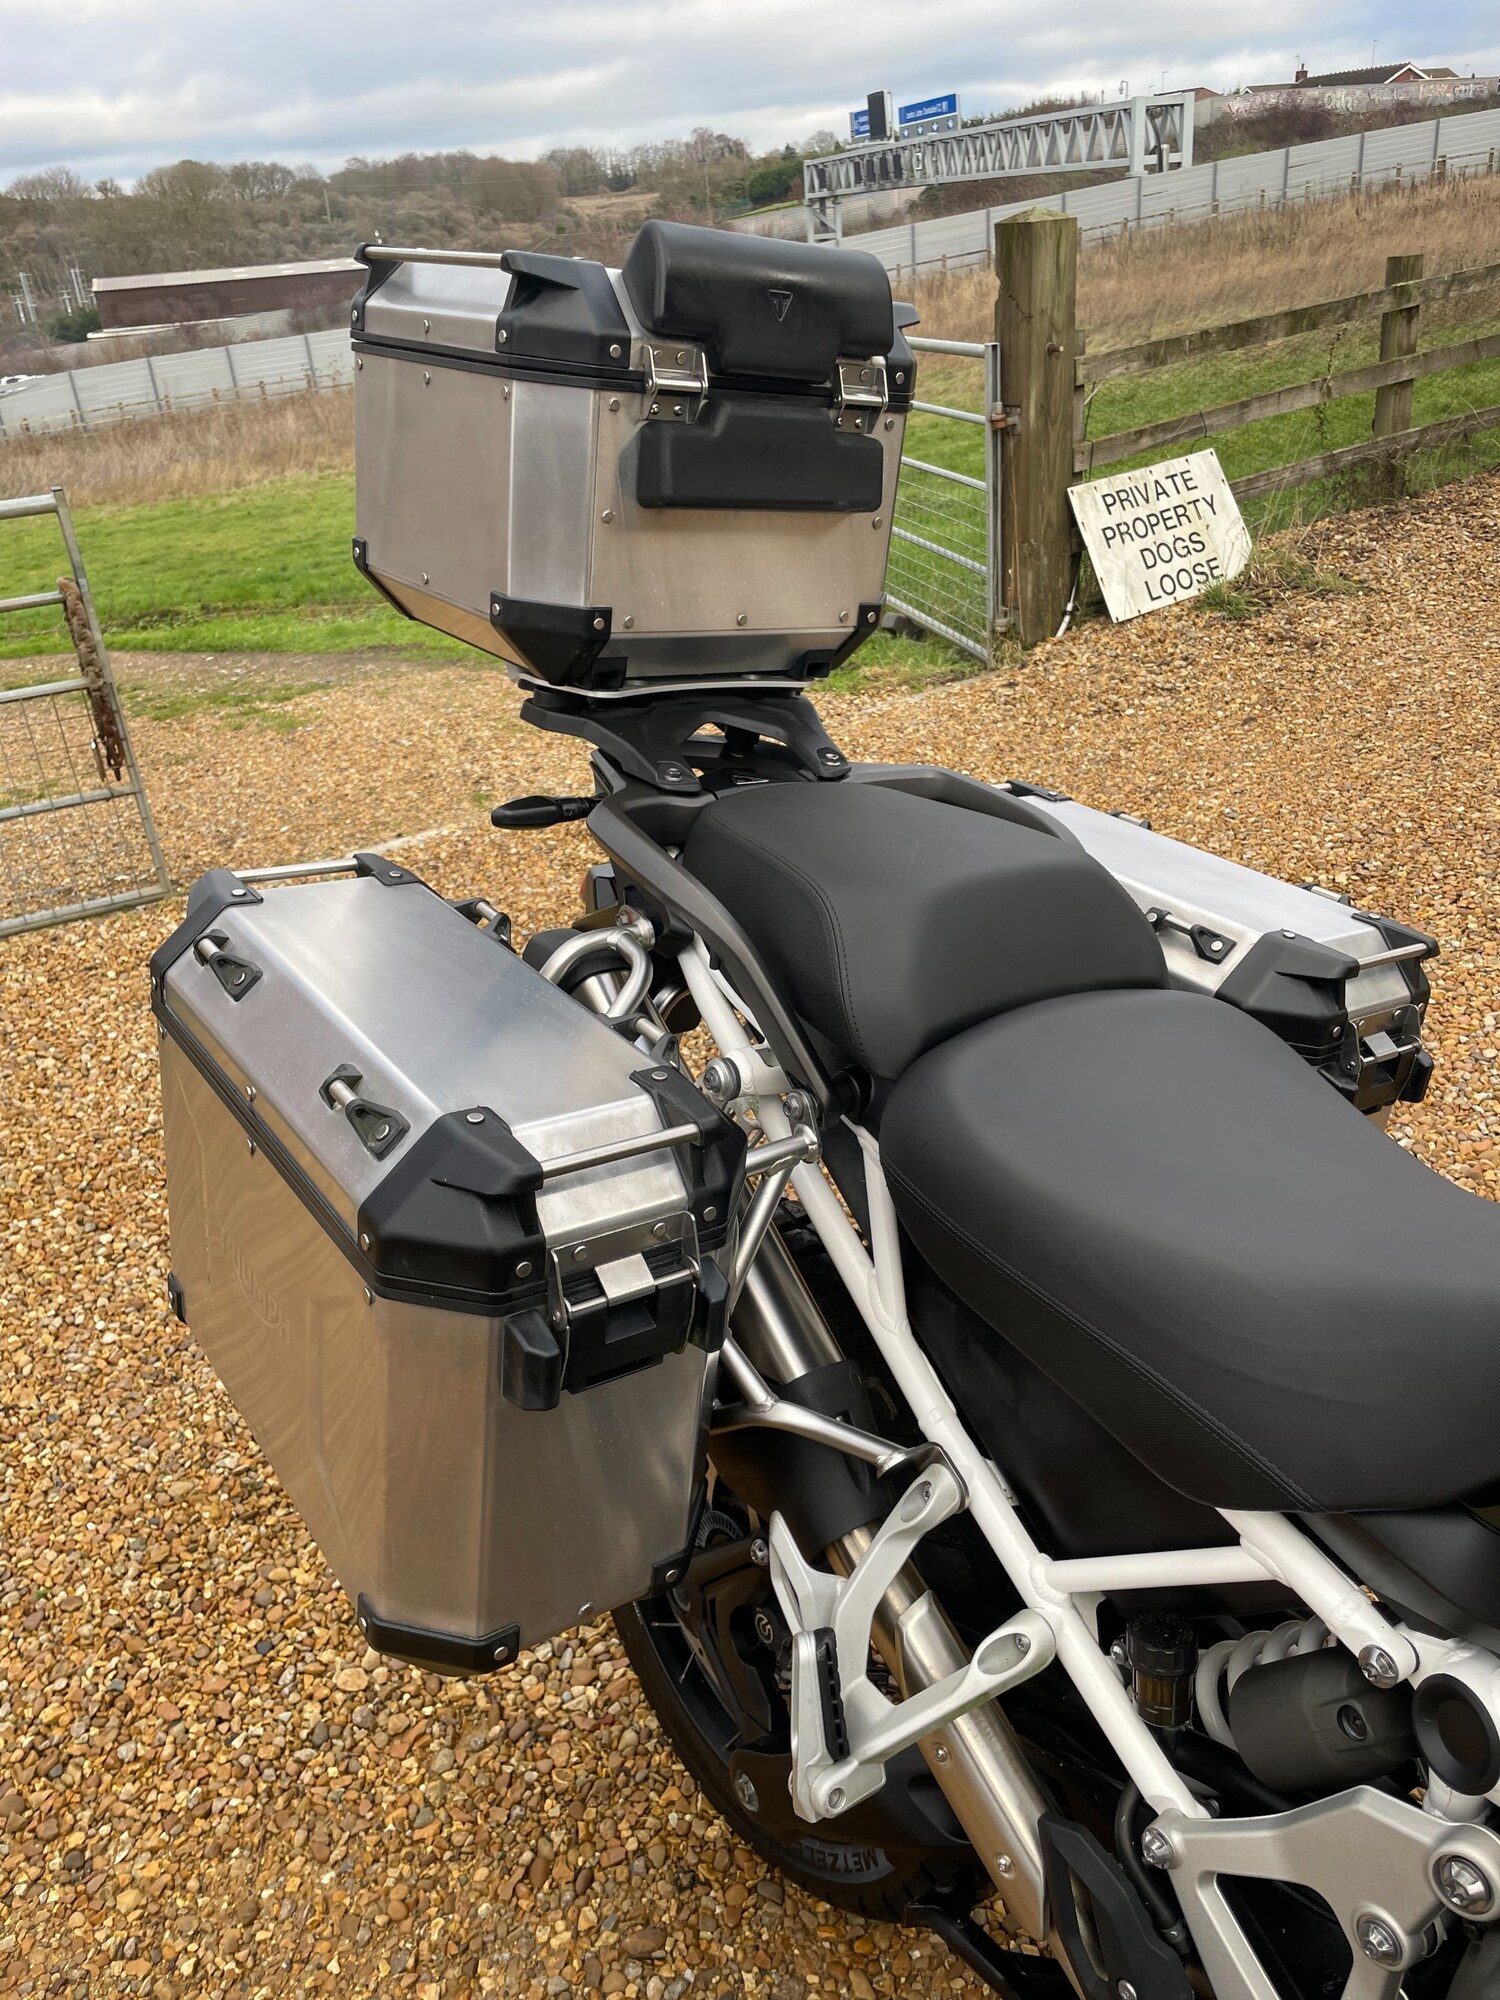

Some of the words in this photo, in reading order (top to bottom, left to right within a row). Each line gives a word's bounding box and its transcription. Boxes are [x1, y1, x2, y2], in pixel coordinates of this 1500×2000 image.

[1101, 469, 1198, 516] PRIVATE
[1101, 494, 1217, 549] PROPERTY
[1139, 531, 1206, 570] DOGS
[1144, 557, 1224, 602] LOOSE
